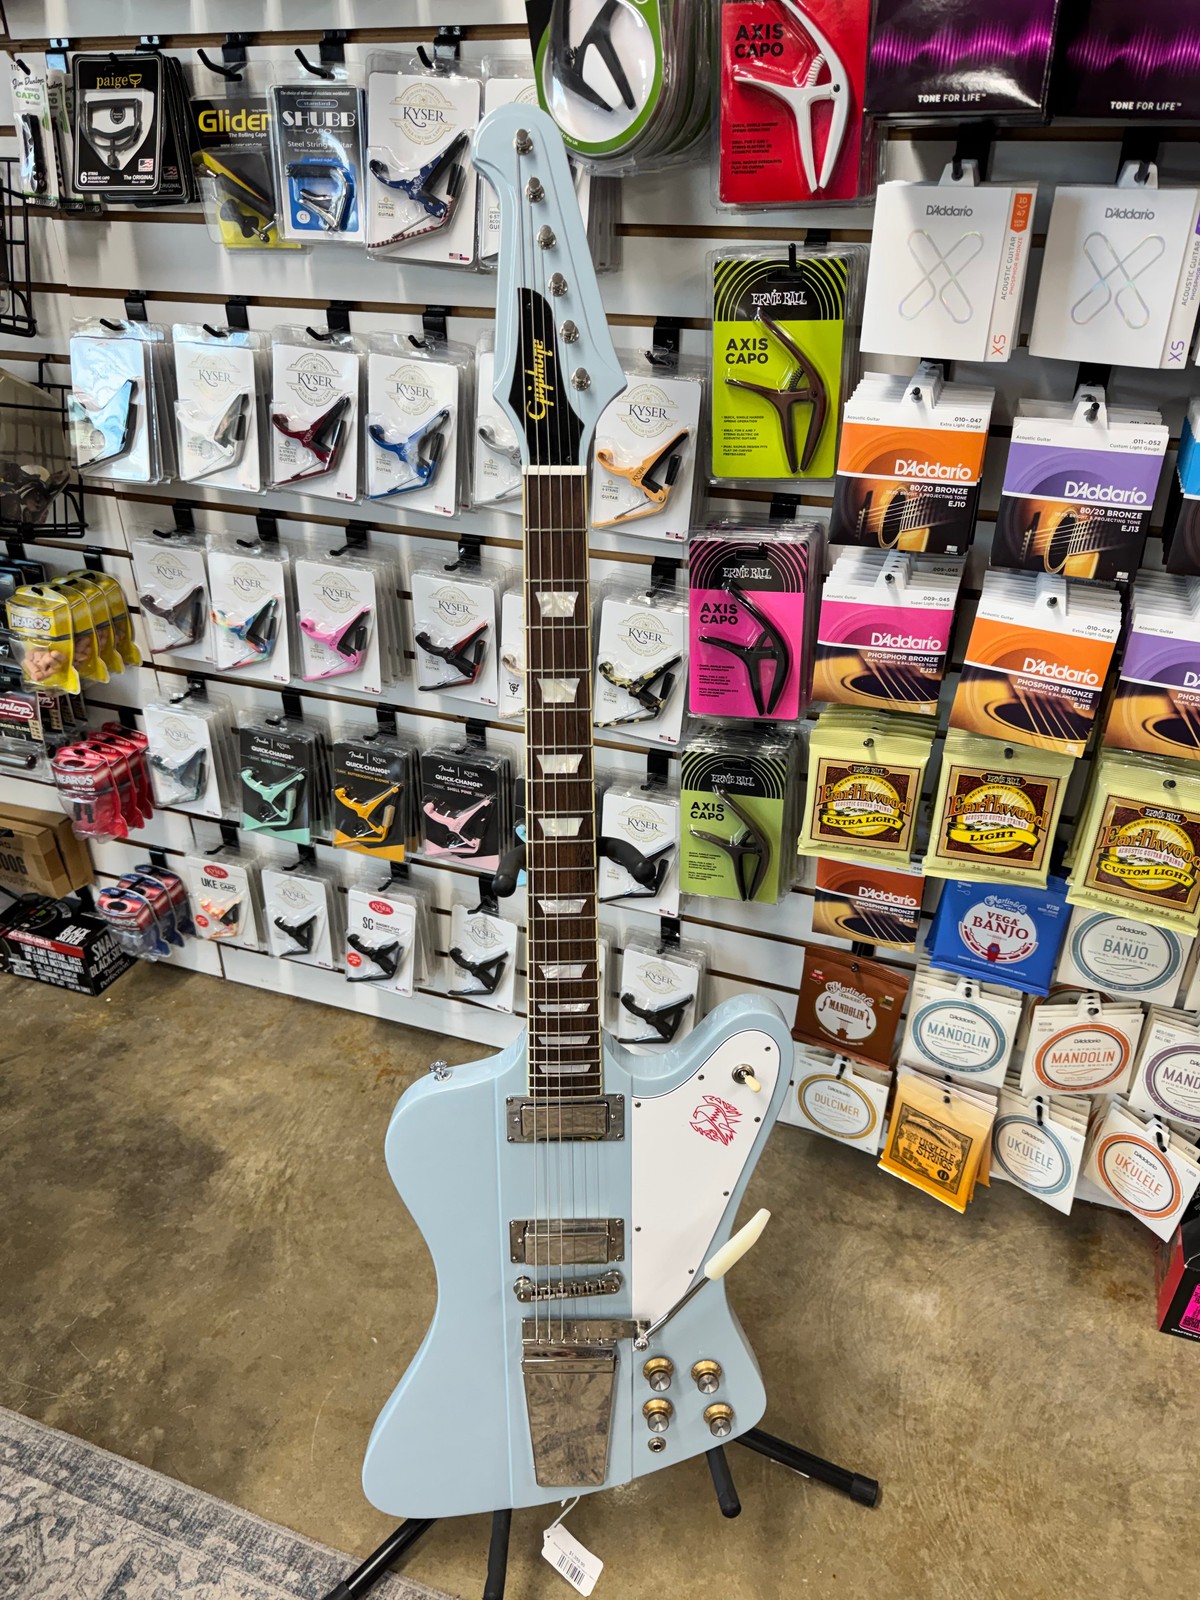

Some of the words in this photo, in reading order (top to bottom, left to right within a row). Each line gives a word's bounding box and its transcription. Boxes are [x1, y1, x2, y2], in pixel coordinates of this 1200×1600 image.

[735, 24, 784, 41] AXIS
[734, 42, 784, 59] CAPO
[96, 73, 128, 89] paige
[15, 91, 40, 100] CAPO
[918, 94, 941, 104] TONE
[943, 93, 960, 102] FOR
[1110, 100, 1134, 110] TONE
[1136, 101, 1154, 111] FOR
[198, 109, 271, 132] Glider
[403, 106, 448, 128] KYSER
[307, 141, 328, 149] String
[80, 172, 87, 184] 6
[926, 204, 973, 217] D'Addario
[1105, 207, 1155, 220] D'Addario
[1001, 266, 1012, 300] ACOUSTIC
[1007, 236, 1017, 265] GUITAR
[1181, 271, 1194, 306] ACOUSTIC
[751, 288, 781, 306] ERNIE
[783, 291, 807, 305] BALL
[726, 338, 768, 351] AXIS
[992, 334, 1006, 356] XS
[1167, 340, 1185, 362] XS
[725, 353, 768, 364] CAPO
[199, 369, 232, 387] KYSER
[298, 372, 334, 392] KYSER
[525, 338, 555, 420] Epiphone
[396, 383, 432, 401] KYSER
[628, 404, 668, 423] KYSER
[894, 459, 971, 480] D'Addario
[1064, 481, 1147, 504] D'Addario
[1080, 507, 1105, 515] 80/20
[1107, 510, 1142, 519] BRONZE
[156, 565, 184, 580] KYSER
[722, 565, 749, 578] ERNIE
[750, 568, 772, 579] BALL
[233, 577, 262, 591] KYSER
[322, 586, 351, 601] KYSER
[438, 601, 470, 615] KYSER
[701, 603, 738, 614] AXIS
[10, 613, 51, 630] HEAROS
[700, 614, 738, 625] CAPO
[628, 627, 663, 644] KYSER
[871, 632, 941, 650] D'Addario
[868, 652, 907, 660] PHOSPHOR
[1022, 657, 1098, 685] D'Addario
[1017, 679, 1059, 692] PHOSPHOR
[1061, 688, 1094, 698] BRONZE
[1178, 692, 1200, 702] PHOS
[349, 751, 365, 761] Fender
[438, 765, 455, 774] Fender
[57, 773, 93, 786] HEAROS
[711, 773, 735, 784] ERNIE
[736, 776, 755, 786] BALL
[447, 786, 460, 794] SHELL
[691, 802, 724, 812] AXIS
[817, 783, 912, 817] Earthwood
[690, 811, 725, 821] CAPO
[874, 804, 892, 813] STRINGS
[945, 794, 1049, 832] Earthwood
[628, 818, 659, 832] KYSER
[827, 817, 863, 825] EXTRA
[866, 817, 898, 825] LIGHT
[989, 814, 1006, 822] GUITAR
[1007, 817, 1027, 828] STRINGS
[969, 831, 1016, 841] LIGHT
[1144, 850, 1163, 859] GUITAR
[1103, 863, 1150, 876] CUSTOM
[1154, 867, 1190, 882] LIGHT
[201, 877, 218, 889] UKE
[220, 883, 236, 891] CAPO
[283, 889, 307, 901] KYSER
[859, 886, 917, 906] D'Addario
[371, 903, 392, 913] KYSER
[856, 901, 888, 910] PHOSPHOR
[362, 917, 374, 931] SC
[972, 916, 1029, 939] BANJO
[1116, 925, 1147, 936] D'Addario
[471, 925, 497, 939] KYSER
[1103, 939, 1148, 960] BANJO
[89, 959, 113, 978] BLACK
[103, 958, 124, 976] Tuning
[645, 971, 673, 986] KYSER
[829, 999, 864, 1020] MANDOLIN
[949, 1014, 976, 1024] D'Addario
[928, 1022, 990, 1049] MANDOLIN
[1051, 1051, 1115, 1063] MANDOLIN
[1163, 1067, 1200, 1089] MAND
[814, 1093, 859, 1117] DULCIMER
[916, 1146, 952, 1171] STRINGS
[919, 1137, 956, 1166] UKULELE
[1007, 1136, 1054, 1170] UKULELE
[1115, 1154, 1163, 1196] UKULELE
